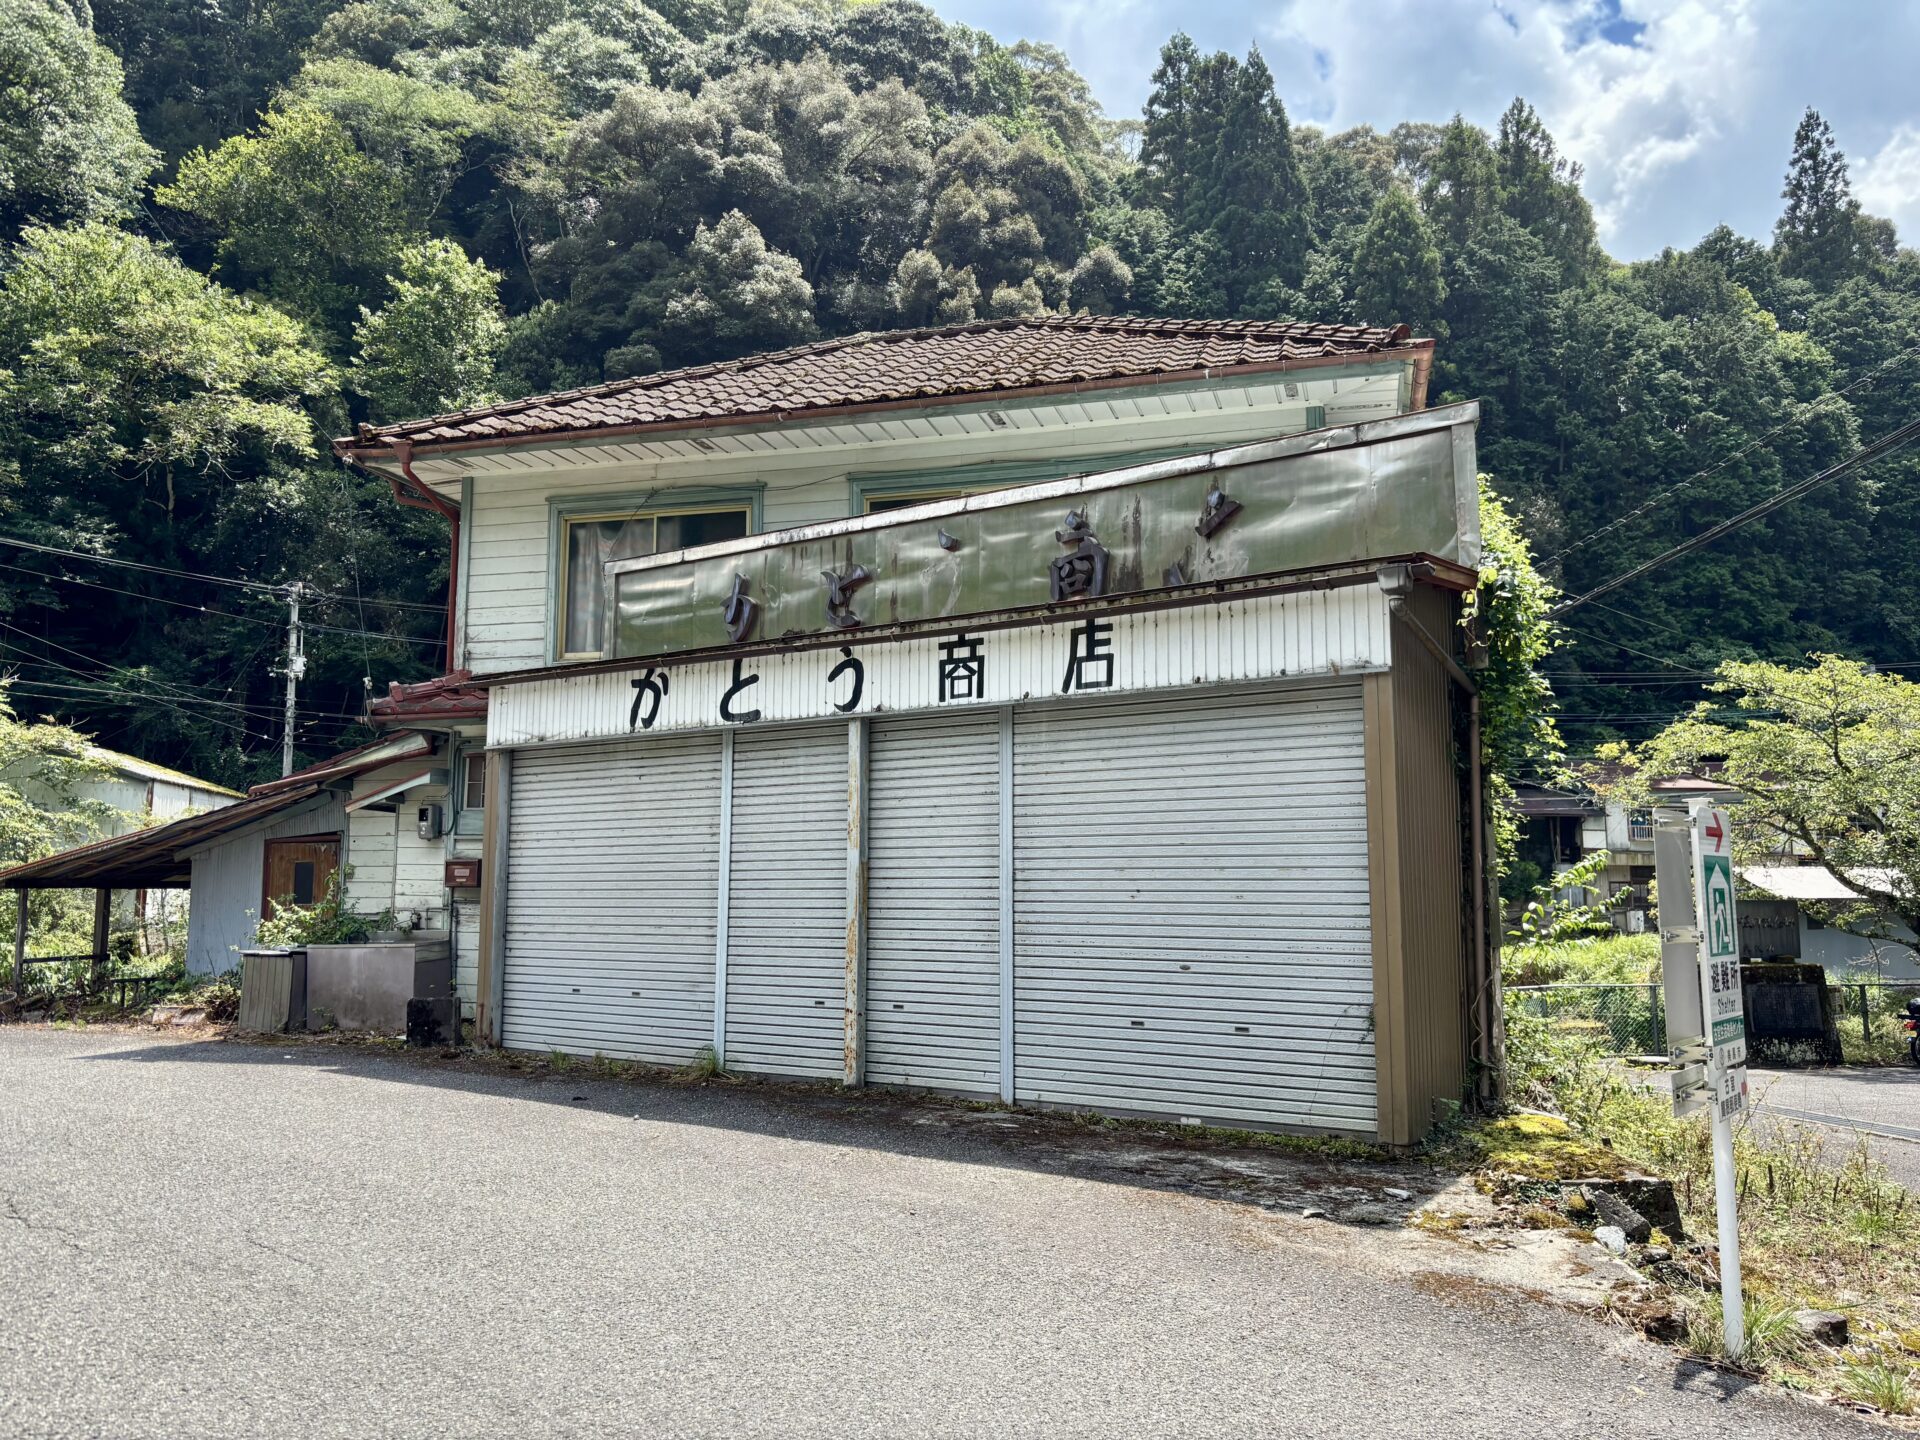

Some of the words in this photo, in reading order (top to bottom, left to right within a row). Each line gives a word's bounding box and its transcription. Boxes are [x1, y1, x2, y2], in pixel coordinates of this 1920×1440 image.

[630, 617, 1114, 733] かとう商店
[1711, 960, 1739, 993] 避難所
[1717, 997, 1736, 1015] Shelter
